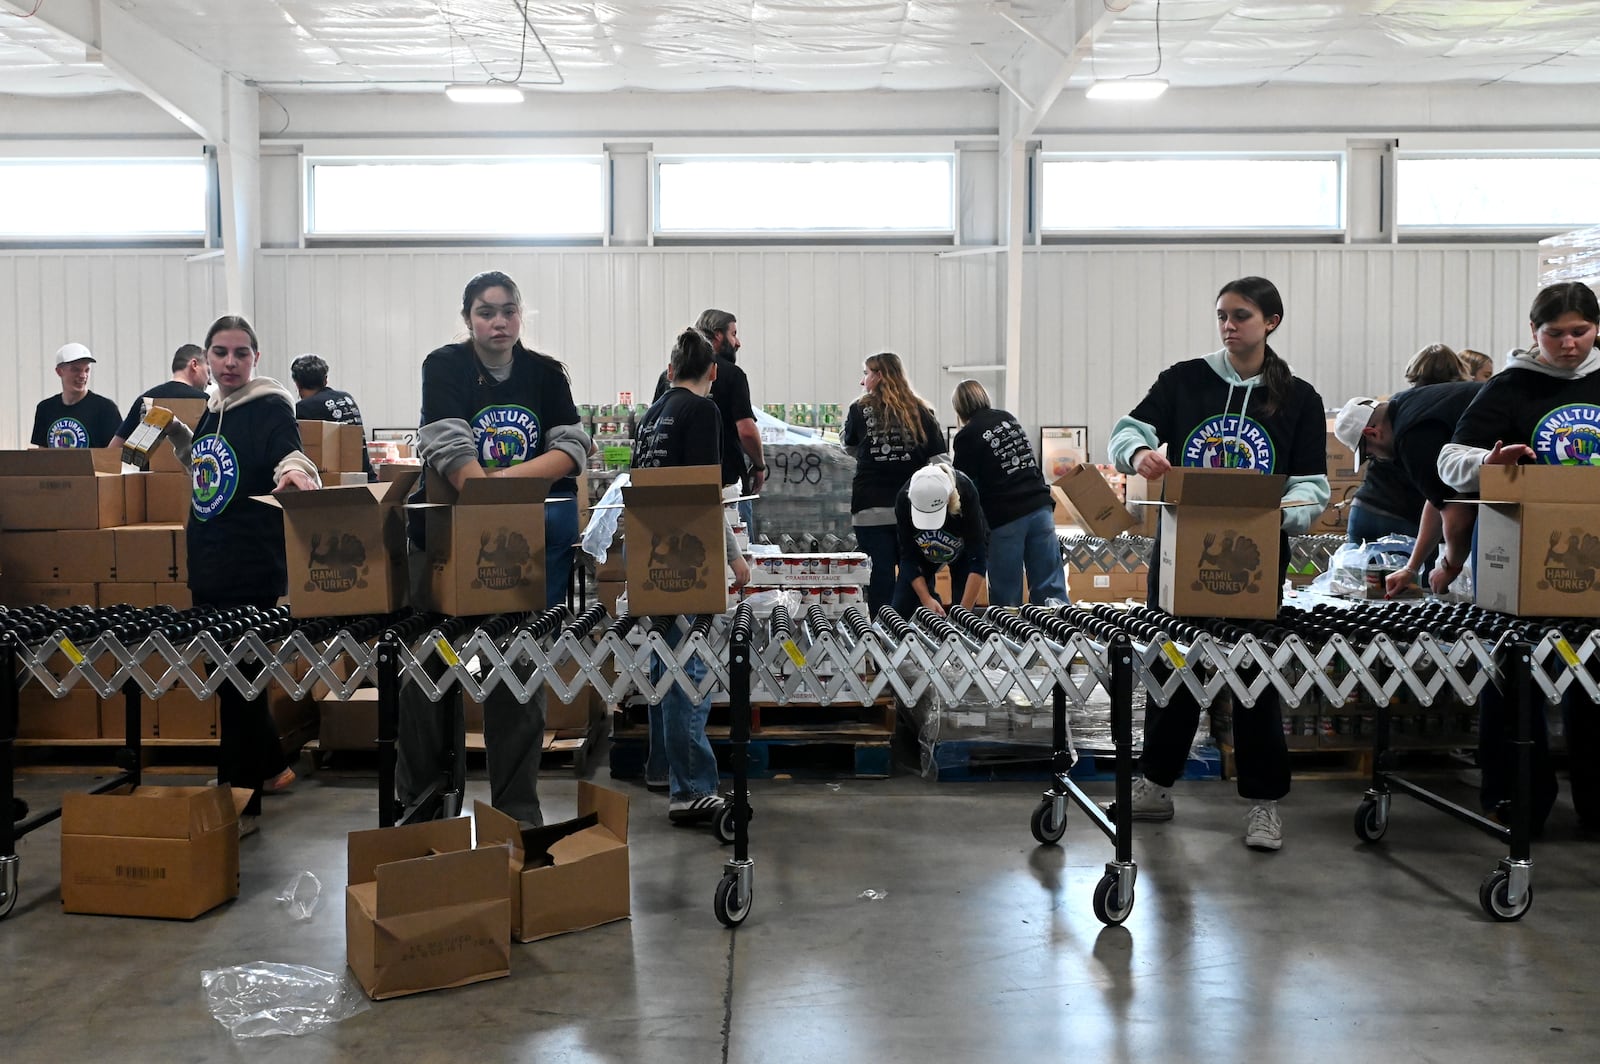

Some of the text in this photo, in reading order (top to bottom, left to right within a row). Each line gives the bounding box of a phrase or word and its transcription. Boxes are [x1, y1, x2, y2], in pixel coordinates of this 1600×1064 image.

[404, 433, 415, 446] 2
[312, 569, 342, 580] HAMIL
[480, 567, 508, 577] HAMIL
[651, 569, 682, 579] HAMIL
[1200, 570, 1233, 581] HAMIL
[1546, 568, 1580, 579] HAMIL
[319, 578, 355, 590] TURKEY
[485, 576, 519, 586] TURKEY
[657, 578, 694, 589] TURKEY
[1206, 581, 1246, 592] TURKEY
[1552, 579, 1592, 590] TURKEY
